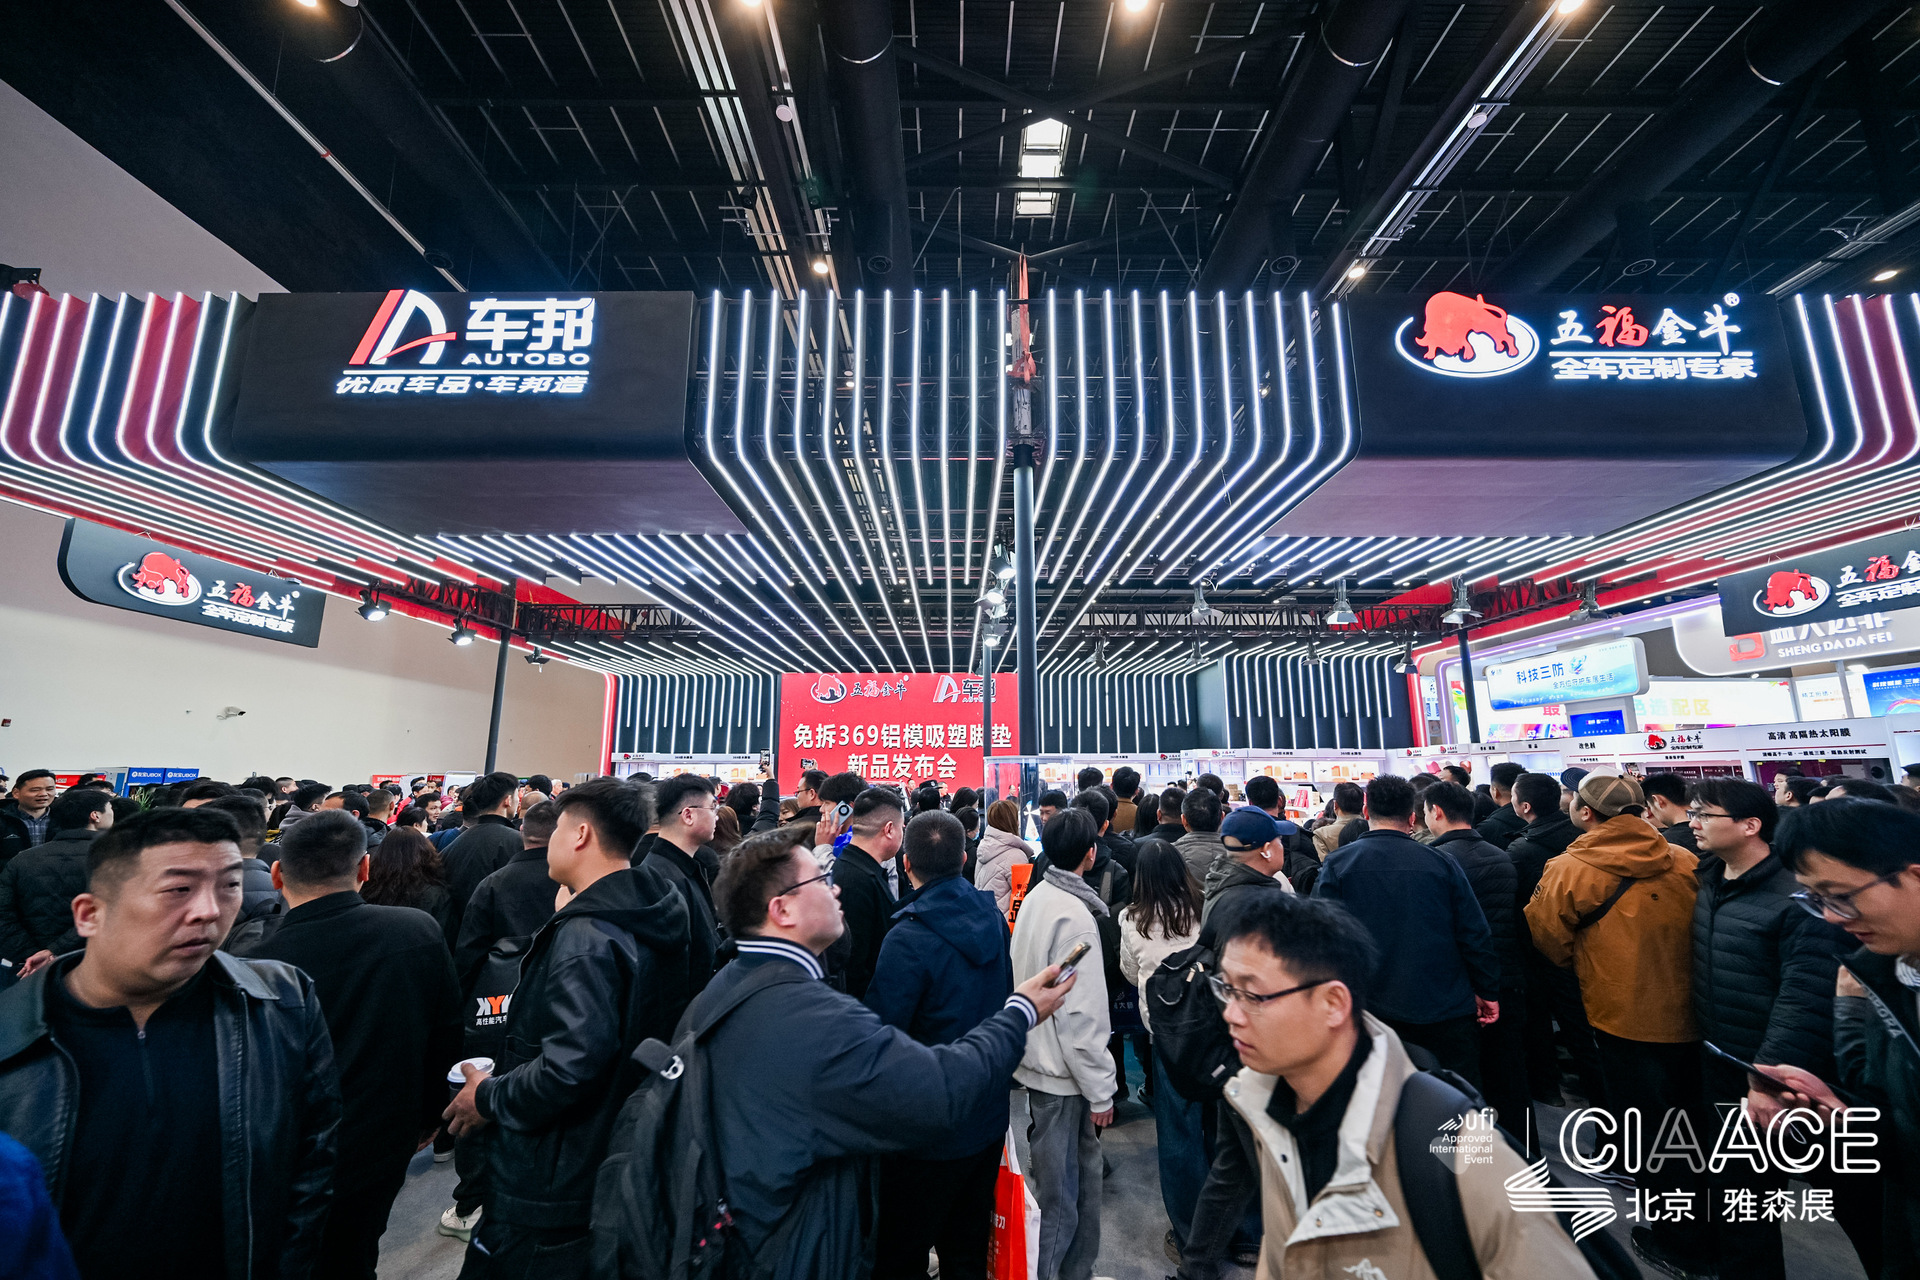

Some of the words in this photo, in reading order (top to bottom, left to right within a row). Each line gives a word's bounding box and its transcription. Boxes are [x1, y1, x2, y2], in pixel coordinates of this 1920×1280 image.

[465, 297, 595, 351] 车邦
[1550, 304, 1741, 355] 五福金牛
[461, 352, 590, 366] AUTOBO
[1551, 357, 1758, 380] 全车定制专家
[206, 580, 295, 620] 五福金牛
[201, 604, 295, 633] 全车定制专家
[1778, 643, 1821, 658] SHENG
[1823, 640, 1844, 651] DA
[1845, 637, 1867, 648] DA
[1868, 632, 1893, 644] FEI
[1516, 663, 1564, 685] 科技三防
[851, 680, 907, 701] 五福金牛
[793, 723, 1012, 748] 免拆369铝模吸塑脚垫
[1768, 731, 1786, 740] 高清
[848, 753, 957, 779] 新品发布会
